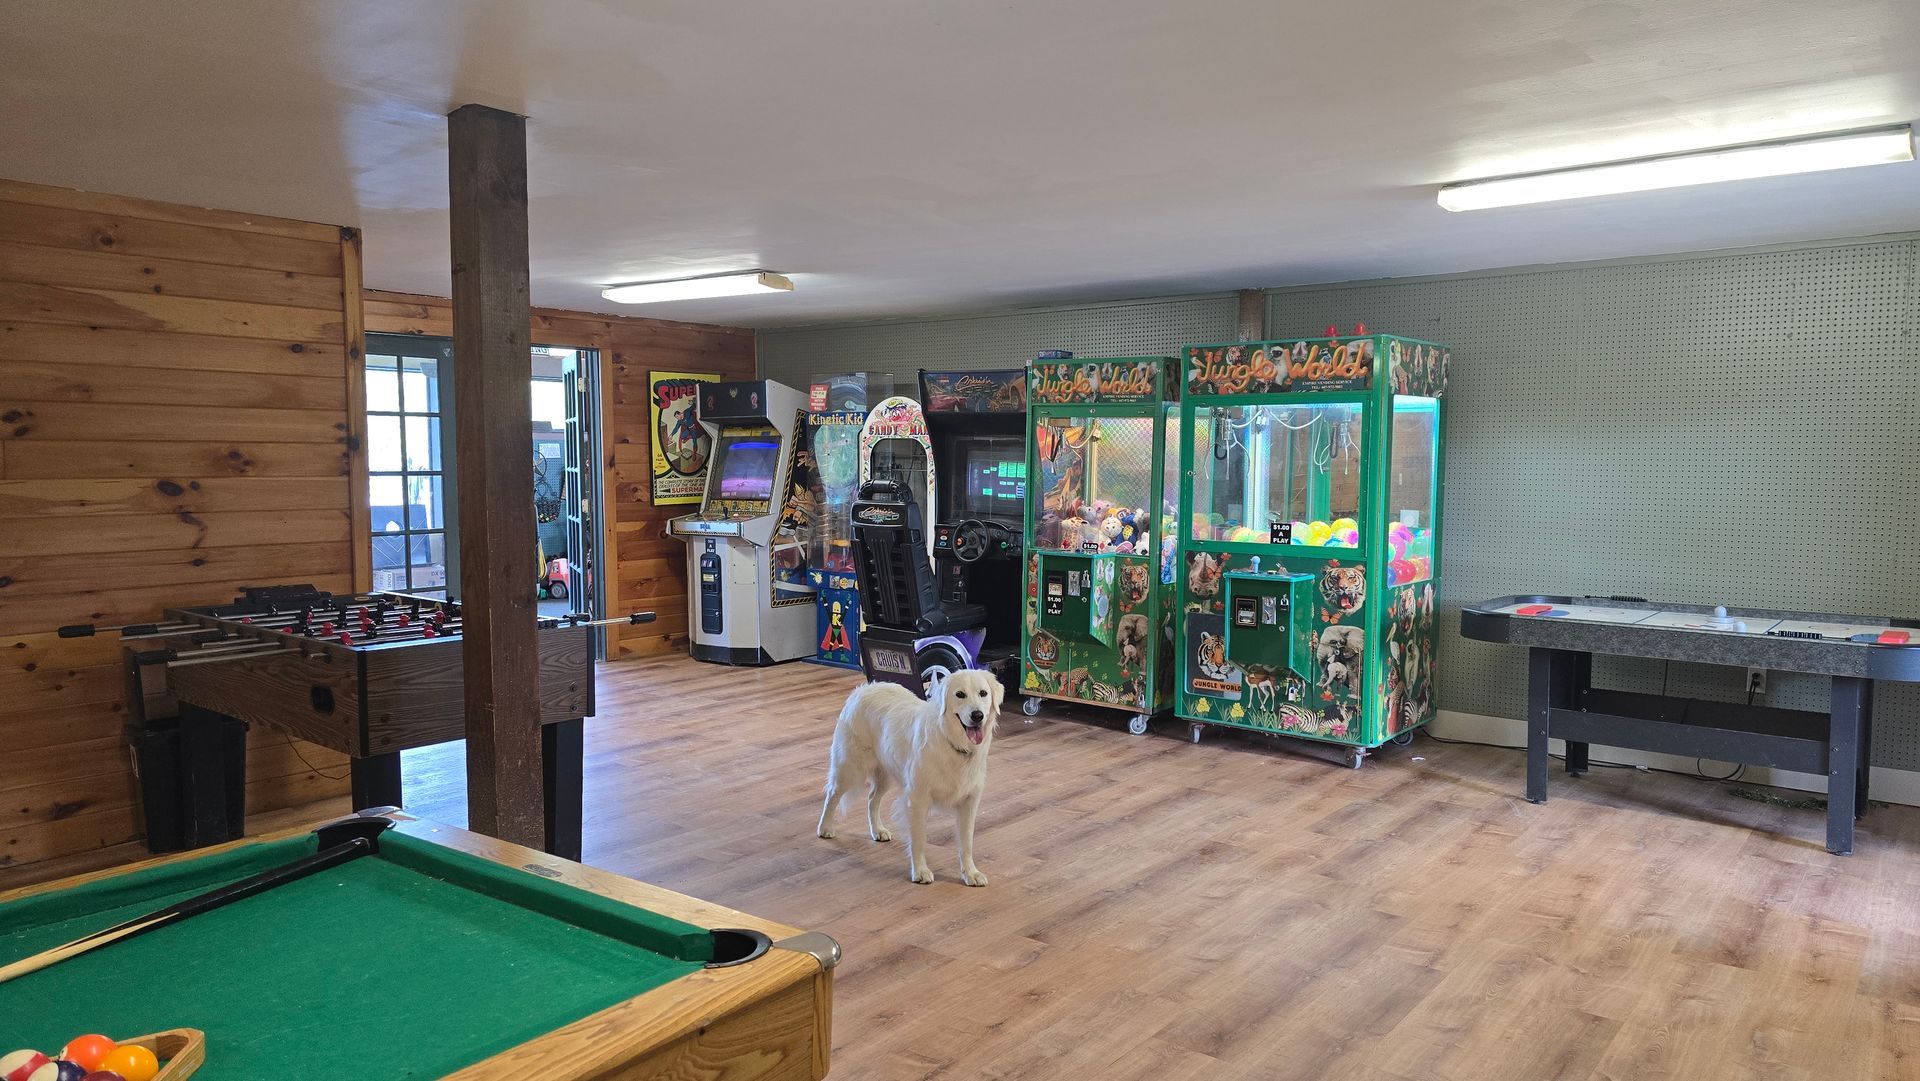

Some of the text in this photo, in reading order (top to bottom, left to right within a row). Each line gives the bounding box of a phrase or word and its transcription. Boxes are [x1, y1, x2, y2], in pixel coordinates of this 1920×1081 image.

[1197, 342, 1368, 394] Jungle World
[1037, 366, 1152, 403] Jungle World
[656, 381, 697, 409] SUPE
[809, 412, 863, 425] Kinetic Kid
[869, 425, 898, 435] CANDY
[1194, 681, 1242, 692] JUNGLE WORLD
